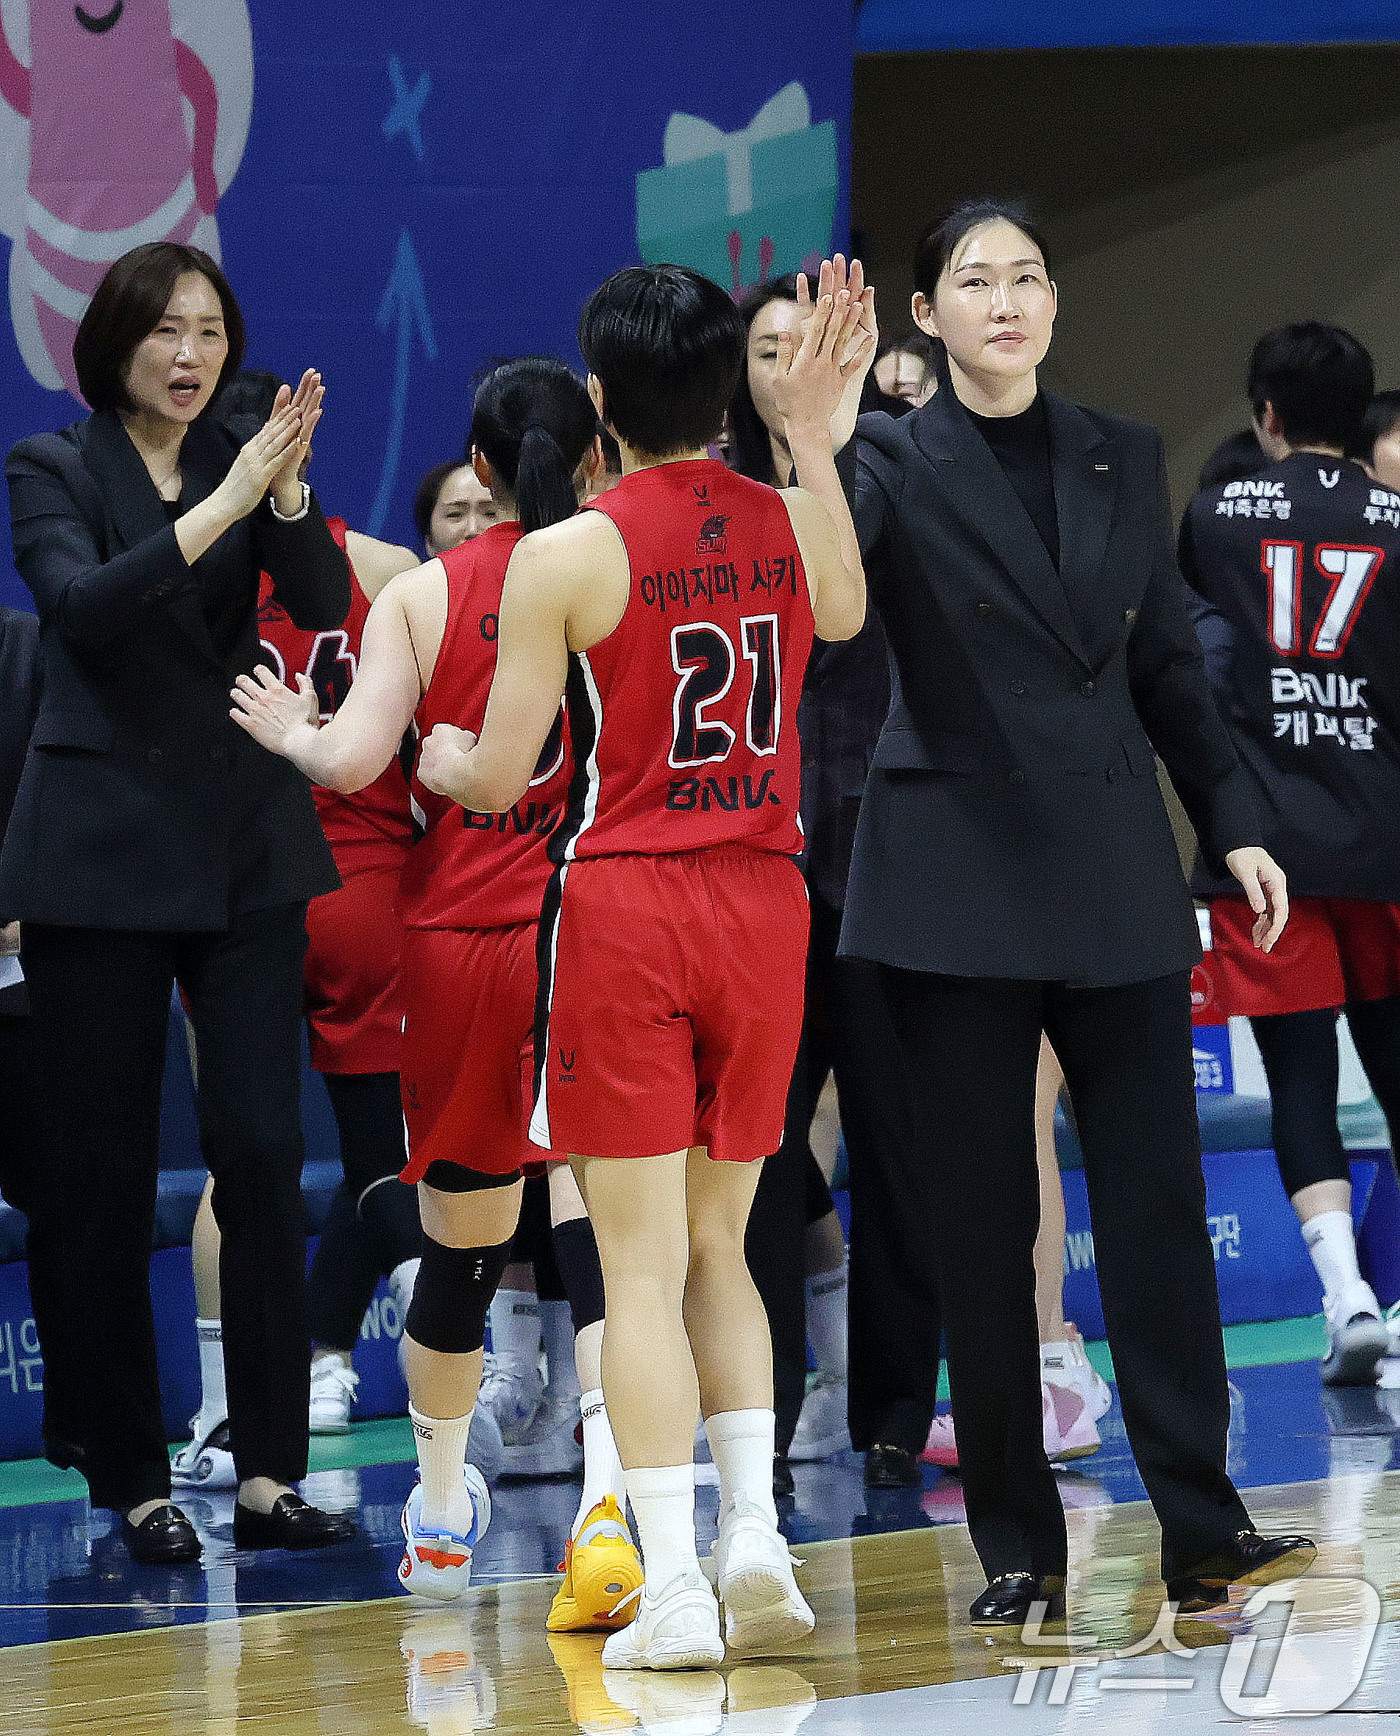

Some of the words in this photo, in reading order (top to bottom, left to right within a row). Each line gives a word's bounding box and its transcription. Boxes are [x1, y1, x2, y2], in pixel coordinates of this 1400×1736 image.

[1222, 480, 1287, 499] BNK
[640, 561, 740, 612] 이이지마
[749, 554, 798, 598] 사키
[1260, 538, 1387, 660] 17
[667, 612, 783, 769] 21
[1270, 667, 1369, 710] BNK
[1272, 709, 1379, 752] 캐피탈
[665, 769, 782, 812] BNK
